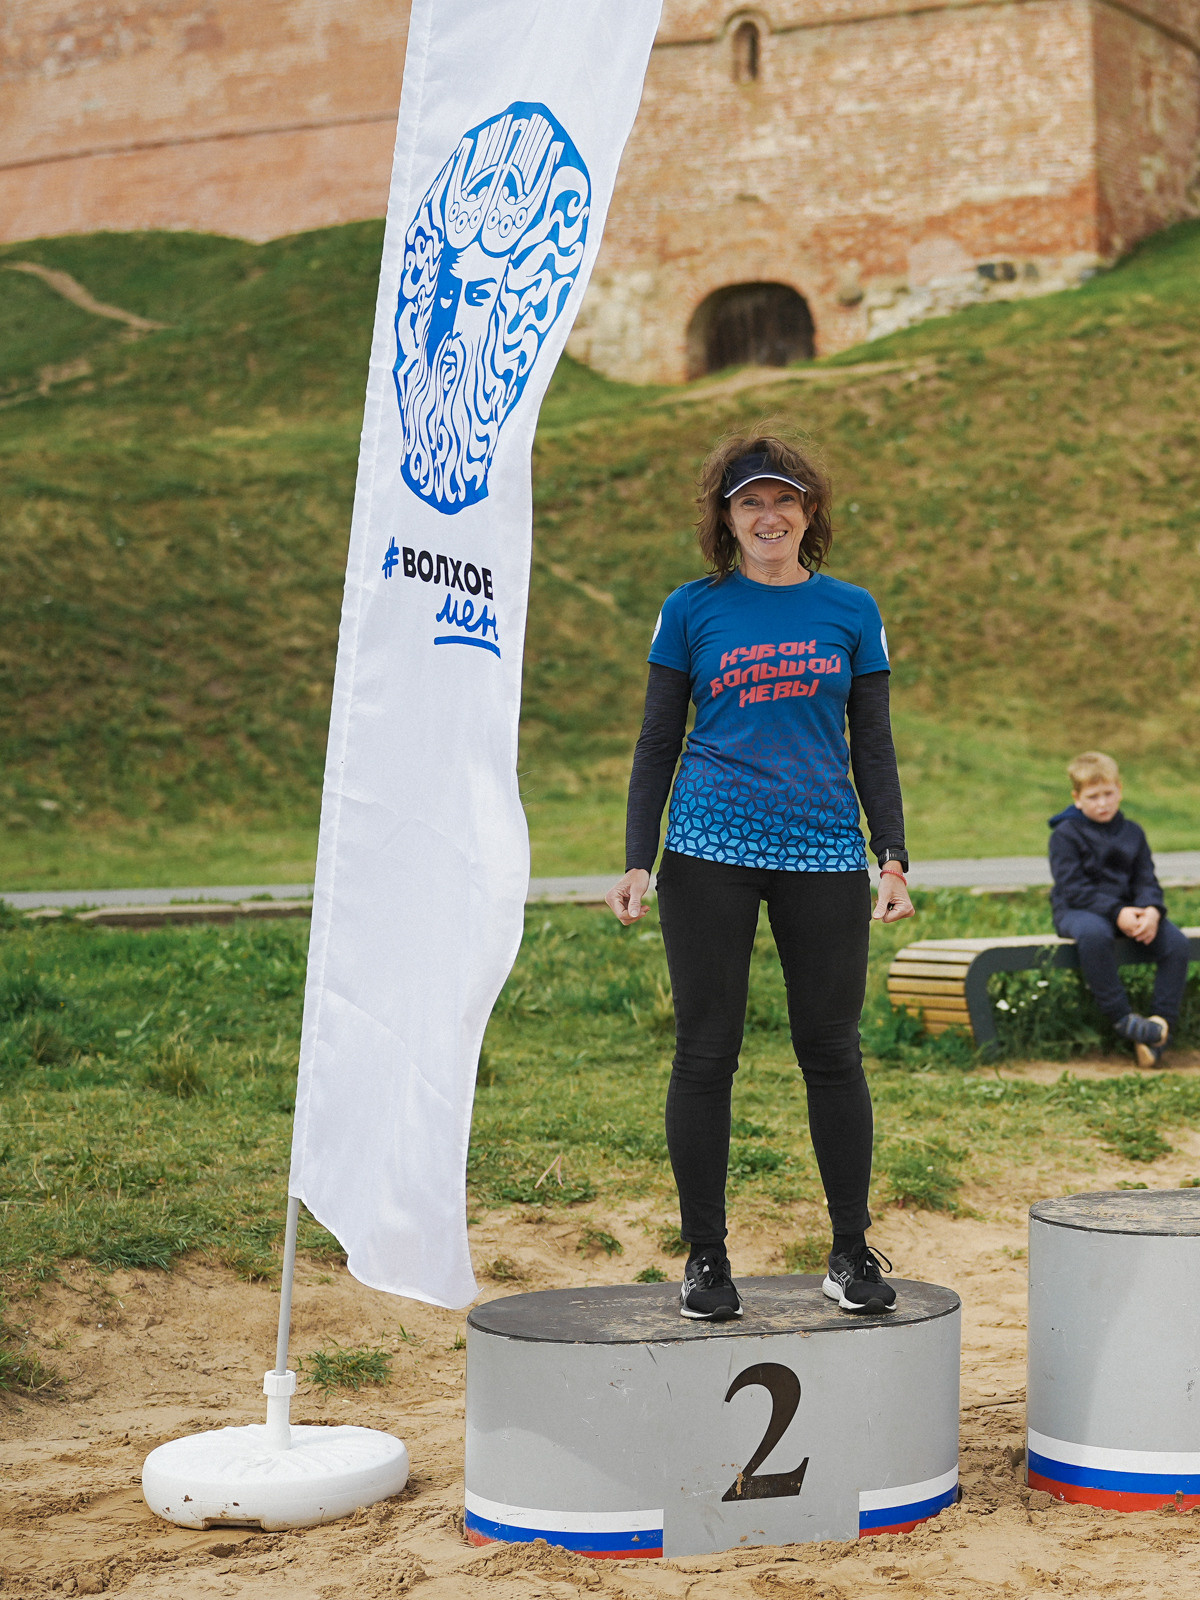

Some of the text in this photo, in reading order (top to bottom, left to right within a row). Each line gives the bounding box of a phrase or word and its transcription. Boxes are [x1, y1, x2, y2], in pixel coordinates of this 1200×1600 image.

[719, 639, 817, 671] КУБОК
[709, 654, 842, 698] БОЛЬШОЙ
[738, 679, 820, 708] НЕВЫ
[721, 1362, 810, 1502] 2
